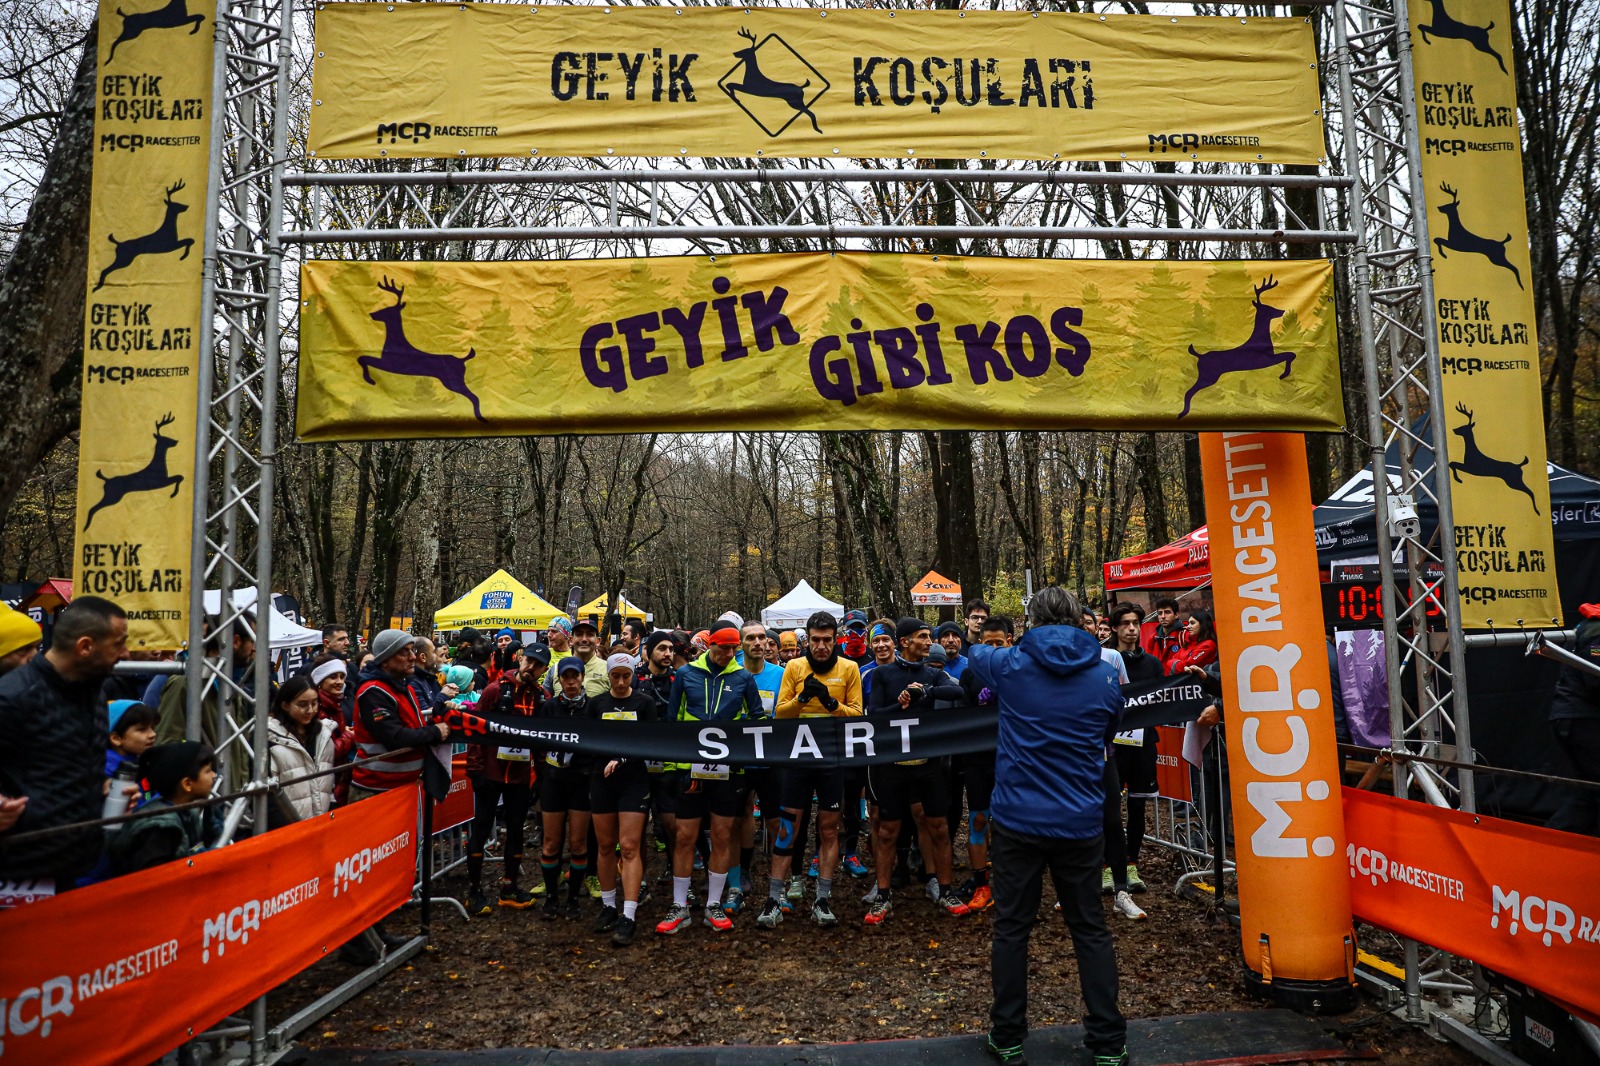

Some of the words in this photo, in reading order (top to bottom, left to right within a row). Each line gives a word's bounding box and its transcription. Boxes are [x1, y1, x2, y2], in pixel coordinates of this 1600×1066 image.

[102, 73, 163, 97] GEYİK
[550, 47, 698, 103] GEYİK
[853, 56, 1096, 114] KOŞULARI
[1421, 82, 1475, 104] GEYİK
[102, 98, 203, 123] KOŞULARI
[1424, 105, 1513, 129] KOŞULARI
[100, 134, 144, 152] MCR
[145, 135, 200, 147] RACESETTER
[377, 122, 431, 144] MCR
[433, 125, 498, 138] RACESETTER
[1148, 133, 1199, 153] MCR
[1201, 134, 1260, 147] RACESETTER
[1425, 137, 1466, 156] MCR
[1467, 141, 1515, 152] RACESETTER
[90, 301, 152, 326] GEYİK
[1438, 297, 1490, 321] GEYİK
[89, 327, 191, 355] KOŞULARI
[579, 276, 801, 393] GEYİK
[808, 302, 954, 407] GİBİ
[954, 307, 1092, 385] KOŞ
[1440, 322, 1528, 347] KOŞULARI
[87, 365, 135, 385] MCR
[136, 366, 189, 379] RACESETTER
[1442, 357, 1483, 376] MCR
[1484, 359, 1530, 371] RACESETTER
[1552, 505, 1583, 525] şler
[1222, 432, 1283, 634] RACESETT
[82, 541, 143, 567] GEYİK
[1188, 544, 1208, 563] PLUS
[1456, 550, 1546, 576] KOŞULARI
[1110, 564, 1123, 577] PLUS
[1343, 566, 1363, 574] PLUS
[1429, 563, 1444, 571] PLU
[81, 568, 182, 597] KOŞULARI
[1498, 588, 1547, 600] RACESETTER
[484, 591, 512, 599] TOHUM
[127, 609, 182, 621] RACESETTER
[452, 617, 482, 627] TOHUM
[512, 618, 537, 626] VAKFI
[1124, 684, 1203, 708] ACESETTER
[697, 717, 920, 760] START
[333, 847, 371, 898] MCR
[372, 831, 410, 865] RACESETTER
[1390, 861, 1465, 902] RACESETTER
[202, 899, 261, 964] MCR
[262, 876, 320, 920] RACESETTER
[1490, 884, 1576, 947] MCR
[0, 974, 74, 1056] CR
[78, 938, 178, 1001] RACESETTER
[1532, 1022, 1552, 1040] PLUS
